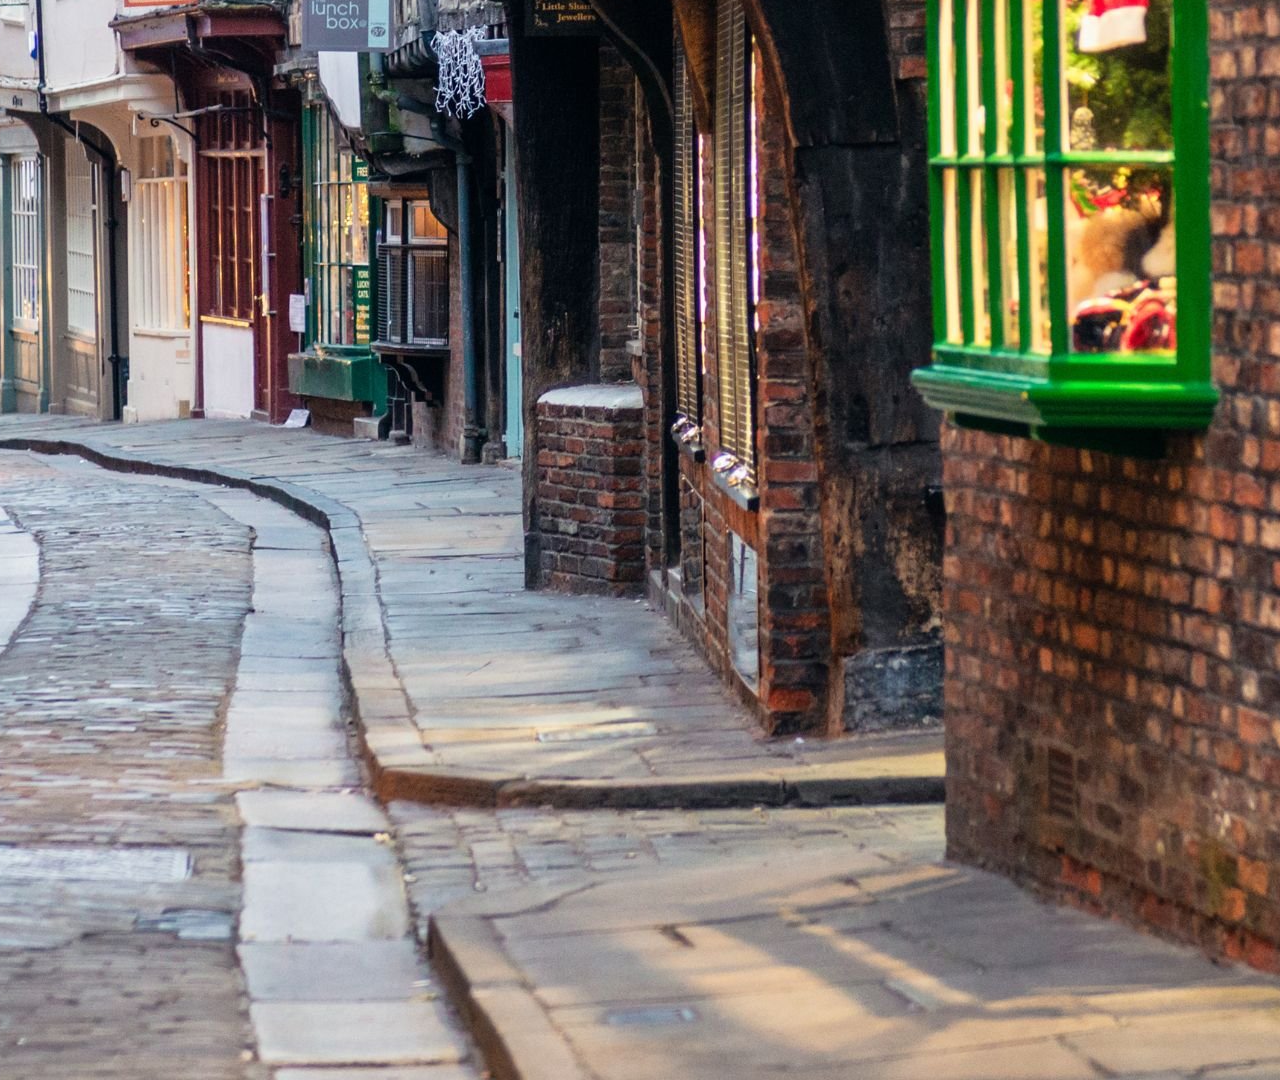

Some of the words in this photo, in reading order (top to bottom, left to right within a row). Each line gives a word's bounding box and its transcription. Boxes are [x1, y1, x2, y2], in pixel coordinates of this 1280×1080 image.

[311, 0, 359, 16] lunch
[542, 2, 566, 10] Little
[327, 15, 359, 29] box
[556, 13, 596, 23] Jewellers
